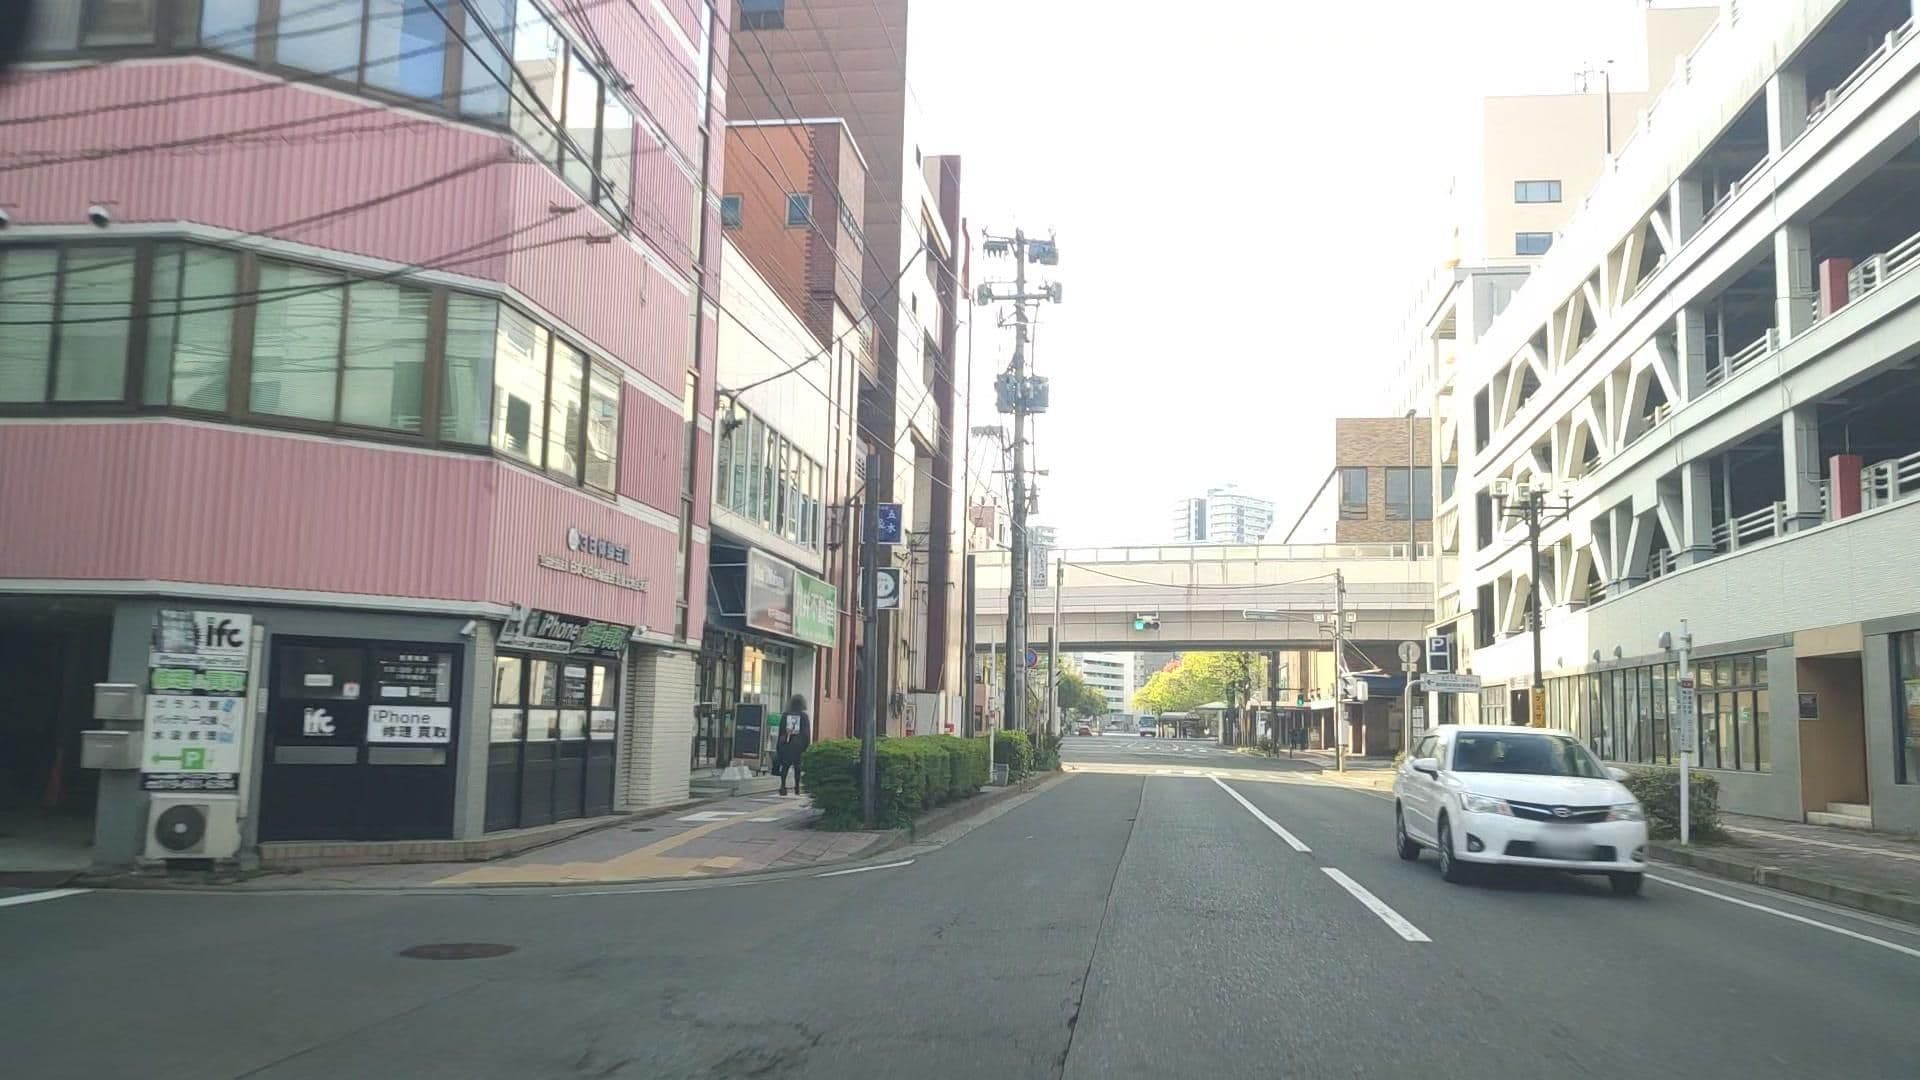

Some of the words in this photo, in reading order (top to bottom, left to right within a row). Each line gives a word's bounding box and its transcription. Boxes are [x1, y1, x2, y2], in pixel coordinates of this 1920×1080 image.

[206, 617, 244, 647] ifc
[538, 614, 580, 640] iPhone
[1432, 638, 1445, 651] P
[303, 707, 336, 734] ifc
[373, 709, 431, 724] iPhone
[184, 751, 201, 768] P
